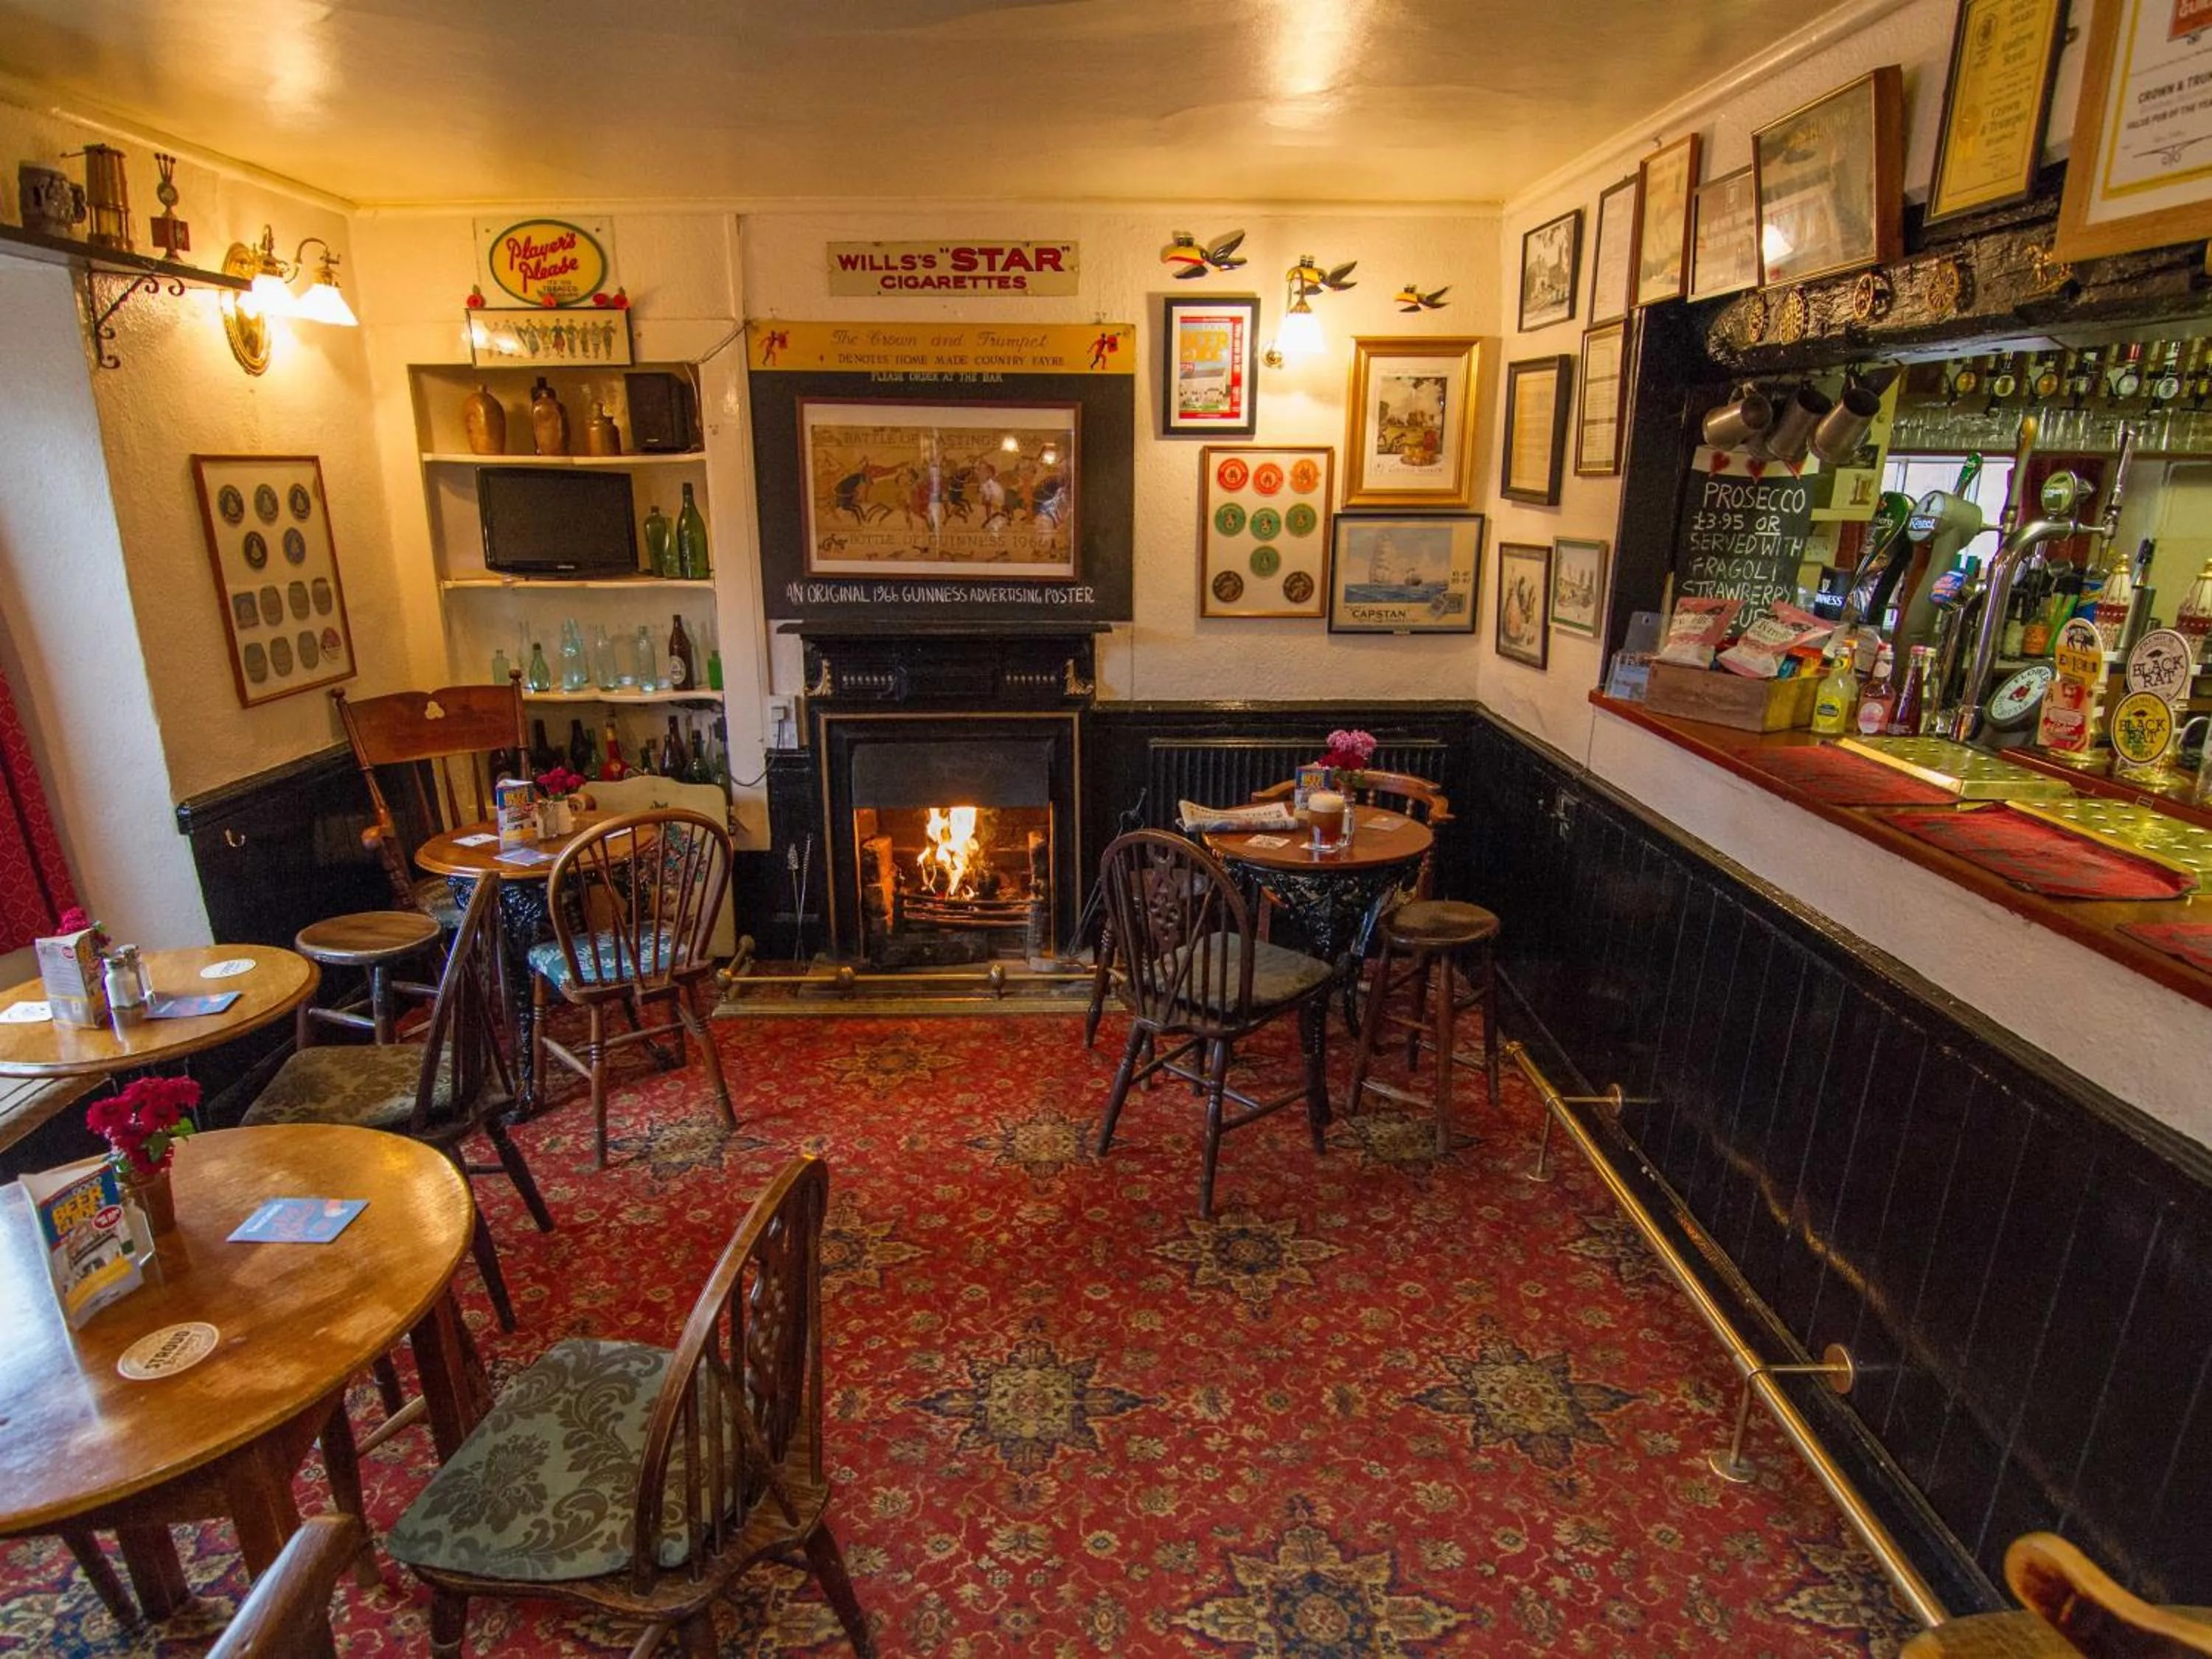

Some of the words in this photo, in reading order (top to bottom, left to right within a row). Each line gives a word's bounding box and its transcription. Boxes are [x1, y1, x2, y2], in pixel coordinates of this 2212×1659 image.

[2138, 83, 2176, 104] CROWN
[506, 231, 577, 271] Player's
[836, 254, 937, 272] WILLS'S
[518, 256, 579, 294] Please
[880, 274, 1028, 290] CIGARETTES
[830, 329, 859, 345] The
[869, 329, 917, 347] Crown
[931, 333, 964, 347] and
[976, 330, 1048, 353] Trumpet
[895, 354, 928, 365] HOME
[933, 355, 968, 366] MADE
[974, 355, 1025, 366] COUNTRY
[1032, 356, 1065, 366] FAYRE
[1703, 481, 1806, 514] PROSECCO
[1755, 515, 1781, 534] OR
[928, 535, 1005, 548] GUINNESS
[1689, 532, 1757, 554] SERVED
[1761, 535, 1804, 557] WITH
[1691, 556, 1777, 582] FRAGOLI
[786, 582, 803, 603] AN
[807, 582, 870, 604] ORIGINAL
[873, 586, 900, 603] 1966
[901, 587, 969, 604] GUINNESS
[970, 588, 1042, 604] ADVERTISING
[1045, 586, 1095, 604] POSTER
[1682, 580, 1794, 607] STRAWBERRY
[2132, 654, 2184, 678] BLACK
[2143, 669, 2175, 689] RAT
[2118, 718, 2167, 734] BLACK
[143, 1330, 191, 1369] STROUD
